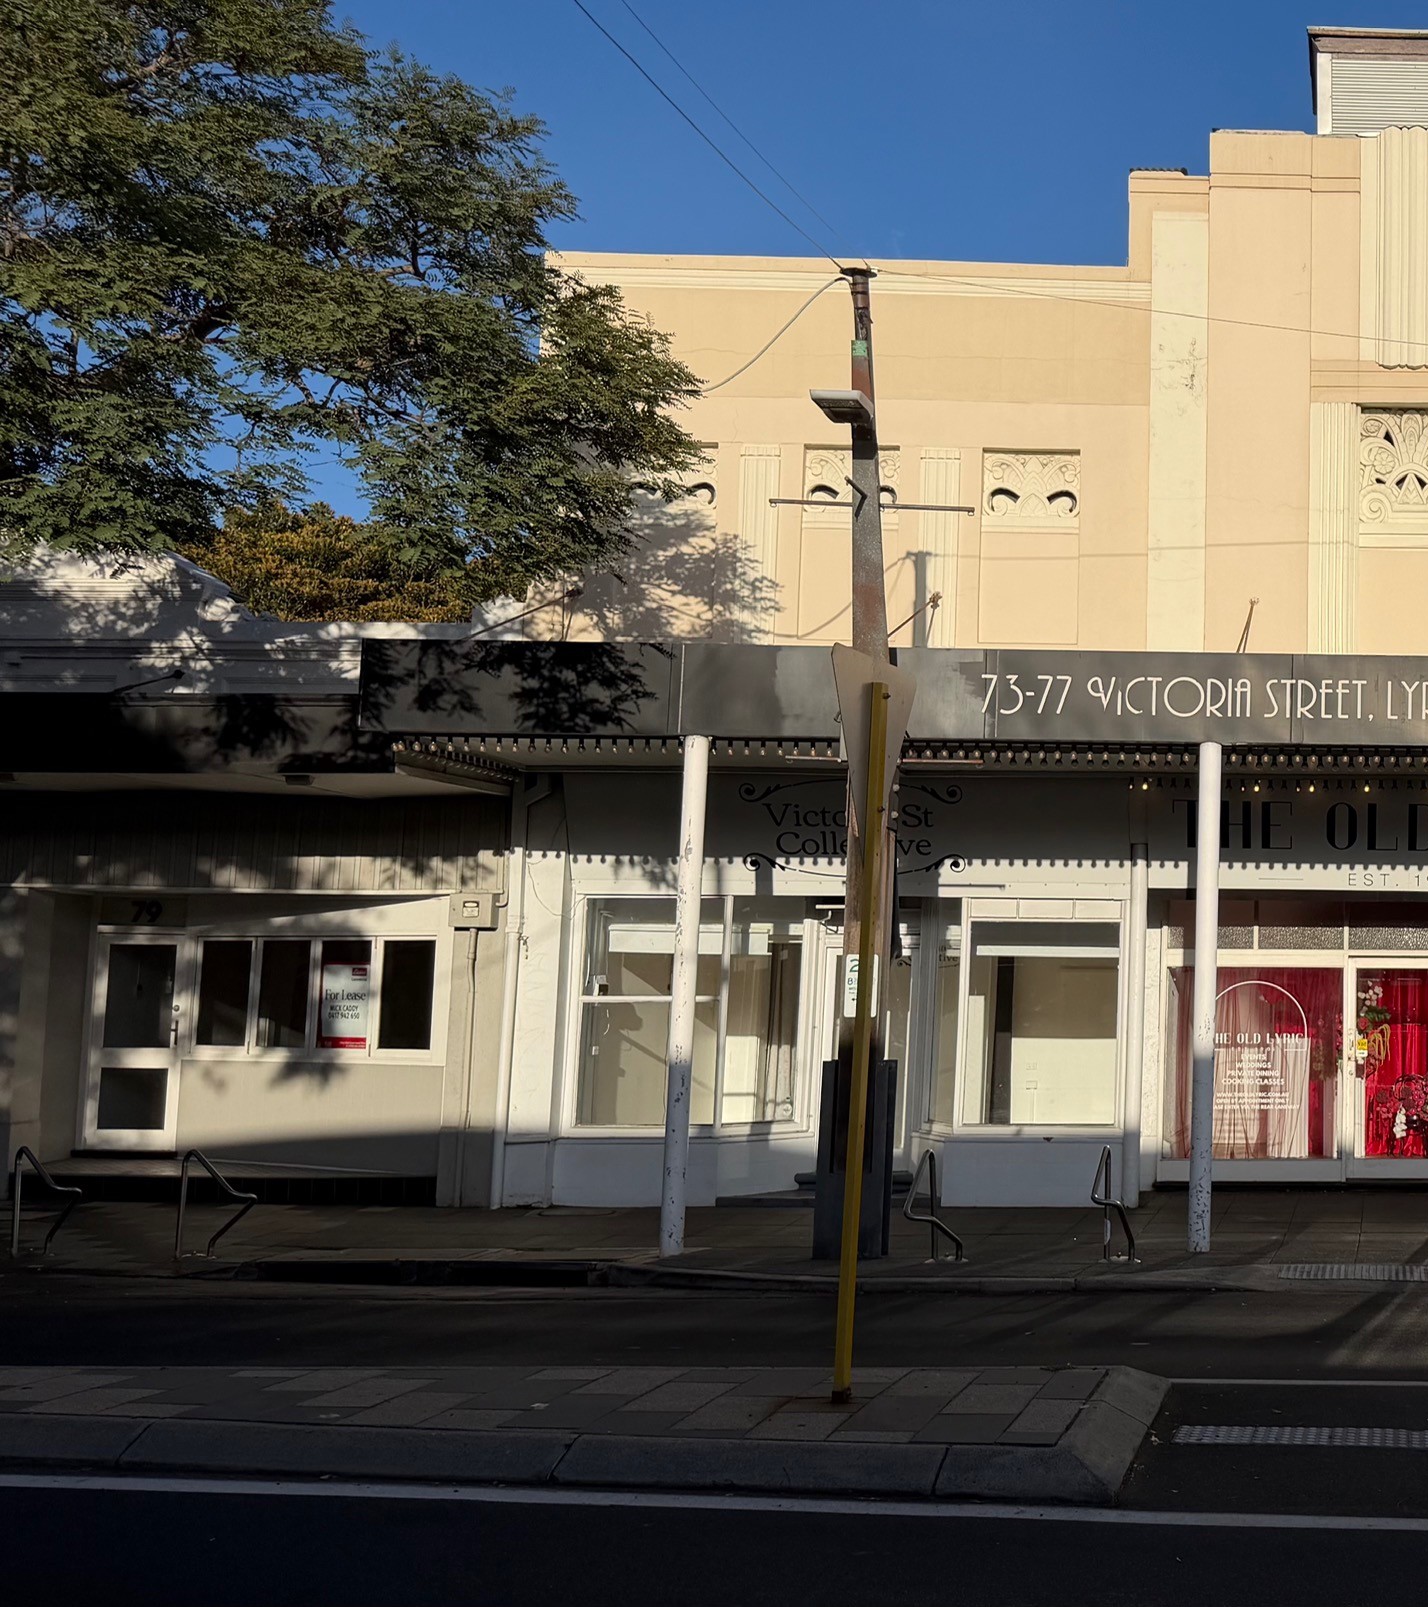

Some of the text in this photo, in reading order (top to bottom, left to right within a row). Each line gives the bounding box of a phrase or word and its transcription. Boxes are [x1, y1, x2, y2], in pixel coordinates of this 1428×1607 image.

[981, 674, 1072, 715] 73-77
[1087, 676, 1251, 718] VICTORIA
[1264, 679, 1375, 722] STREET,
[762, 802, 934, 828] Victo St
[1173, 799, 1293, 850] THE
[1348, 873, 1399, 887] EST.
[131, 901, 163, 923] 79
[325, 989, 366, 1001] For Lease
[1214, 1033, 1304, 1044] HE OLD LYRIC
